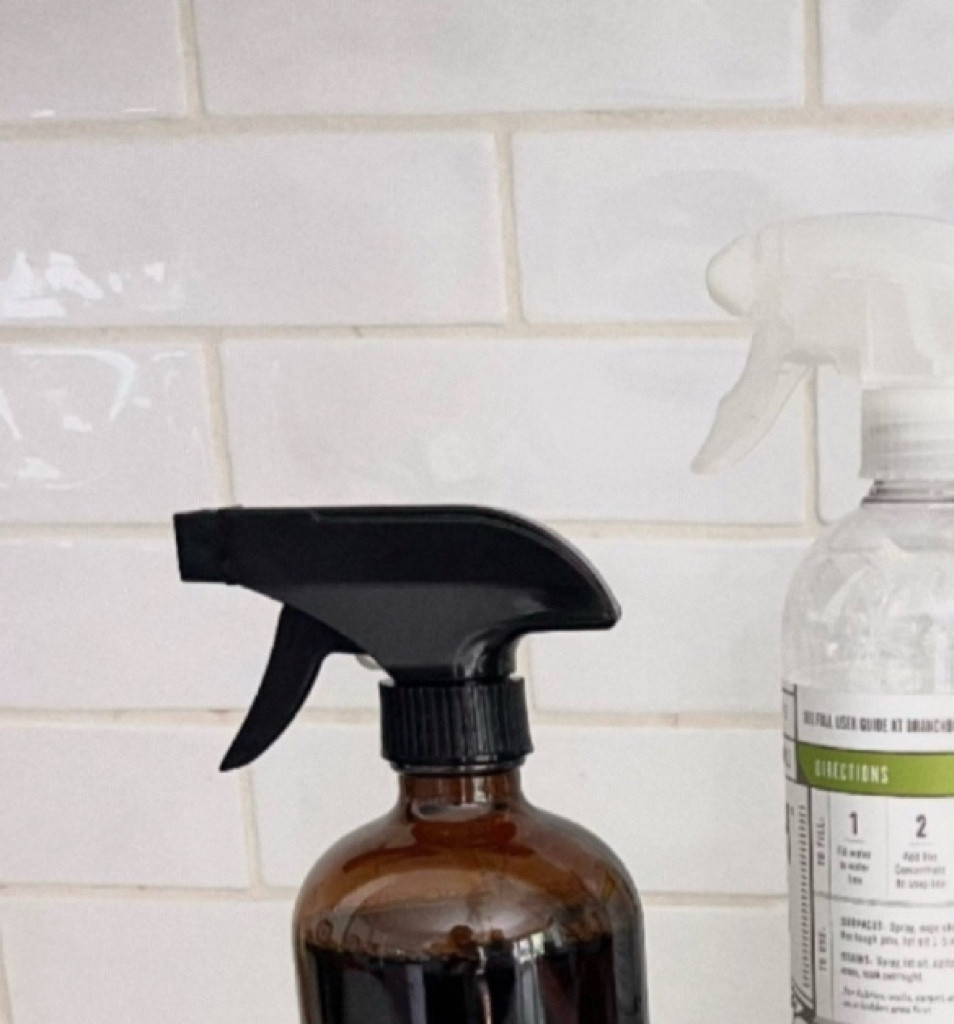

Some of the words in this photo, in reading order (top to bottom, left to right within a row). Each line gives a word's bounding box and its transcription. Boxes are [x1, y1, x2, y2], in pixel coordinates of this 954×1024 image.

[835, 715, 857, 731] USER
[859, 717, 888, 732] GUIDE
[890, 718, 903, 733] AT
[814, 759, 889, 785] DIRECTIONS
[848, 810, 859, 836] 1
[914, 813, 928, 839] 2
